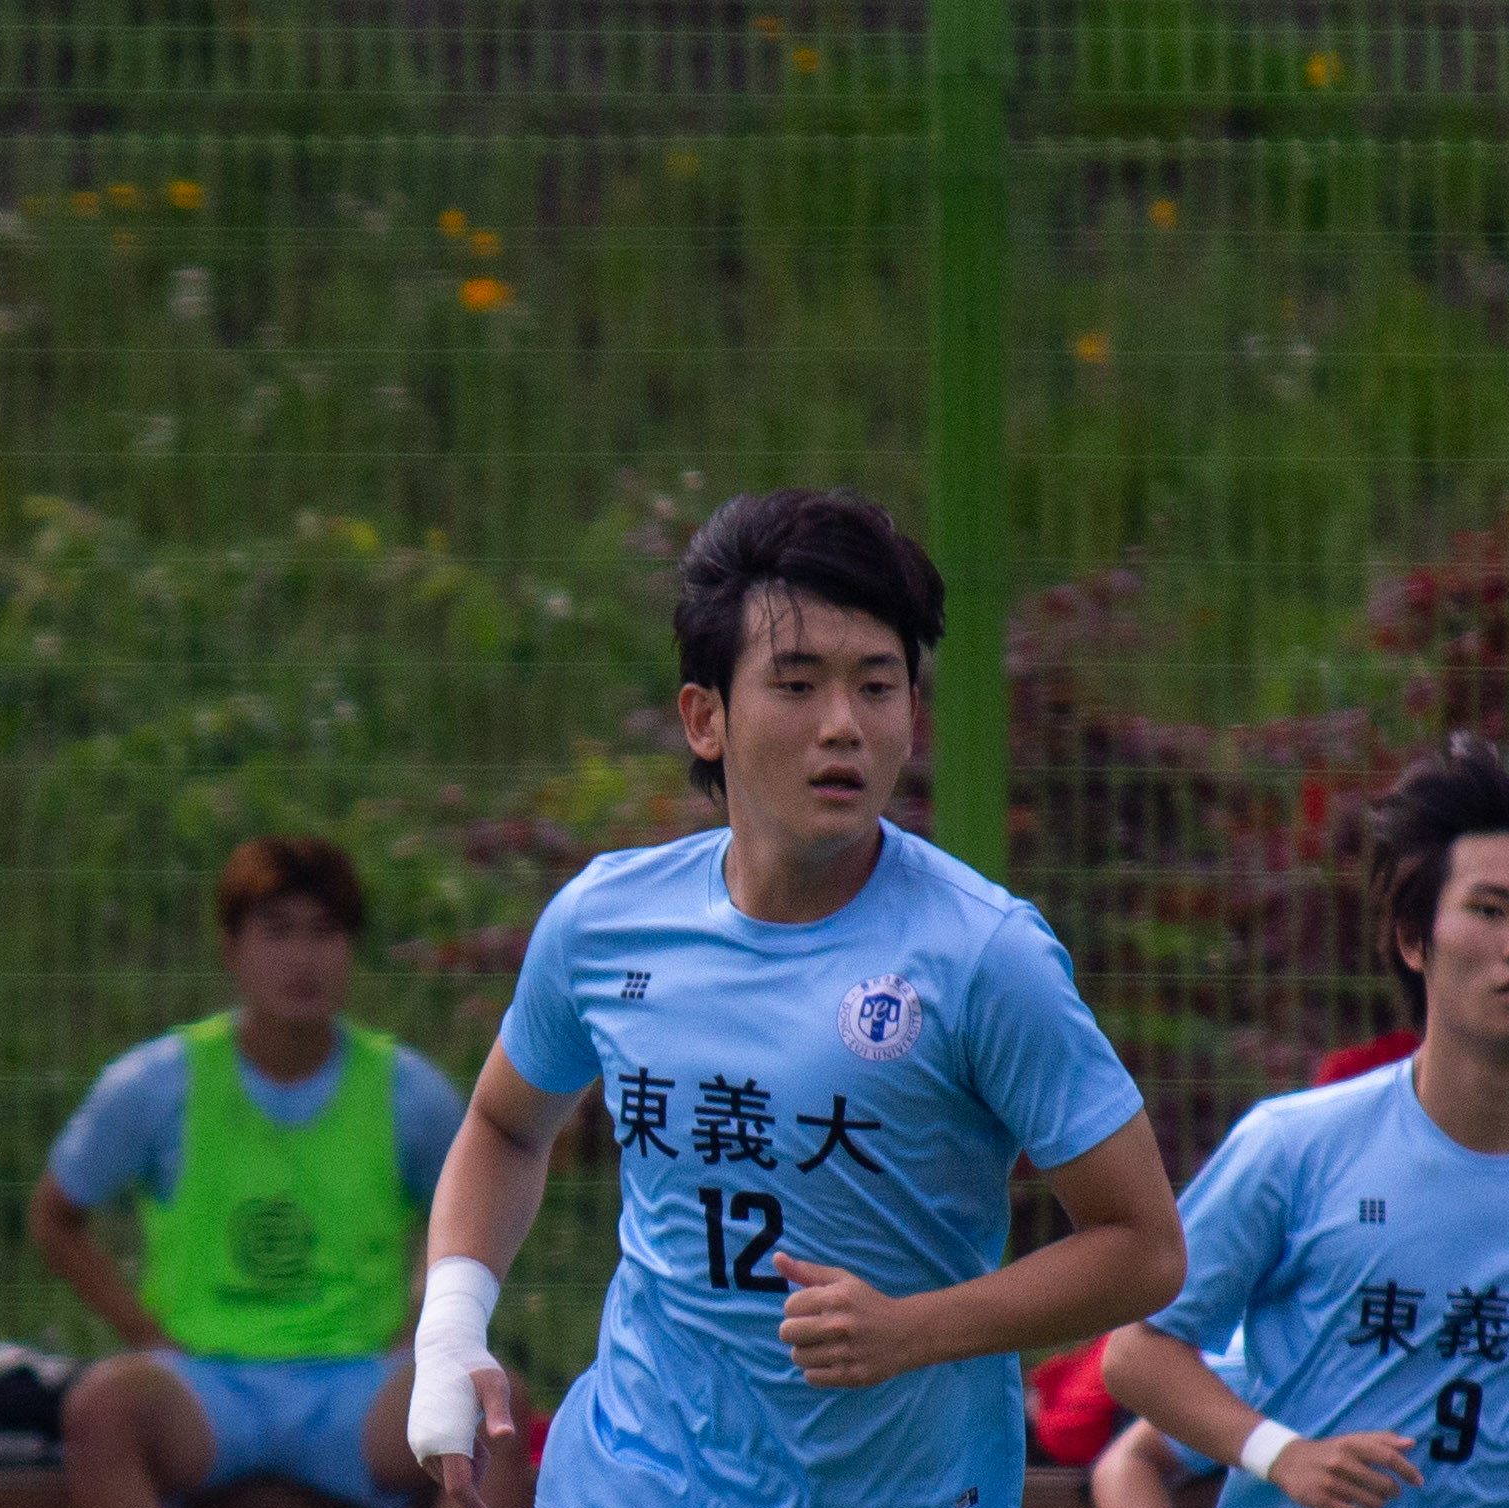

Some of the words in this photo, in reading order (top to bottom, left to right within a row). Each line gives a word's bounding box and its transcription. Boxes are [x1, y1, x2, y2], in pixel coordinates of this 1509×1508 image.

[617, 1067, 885, 1174] 東義大
[699, 1187, 789, 1293] 12
[1429, 1378, 1483, 1463] 9
